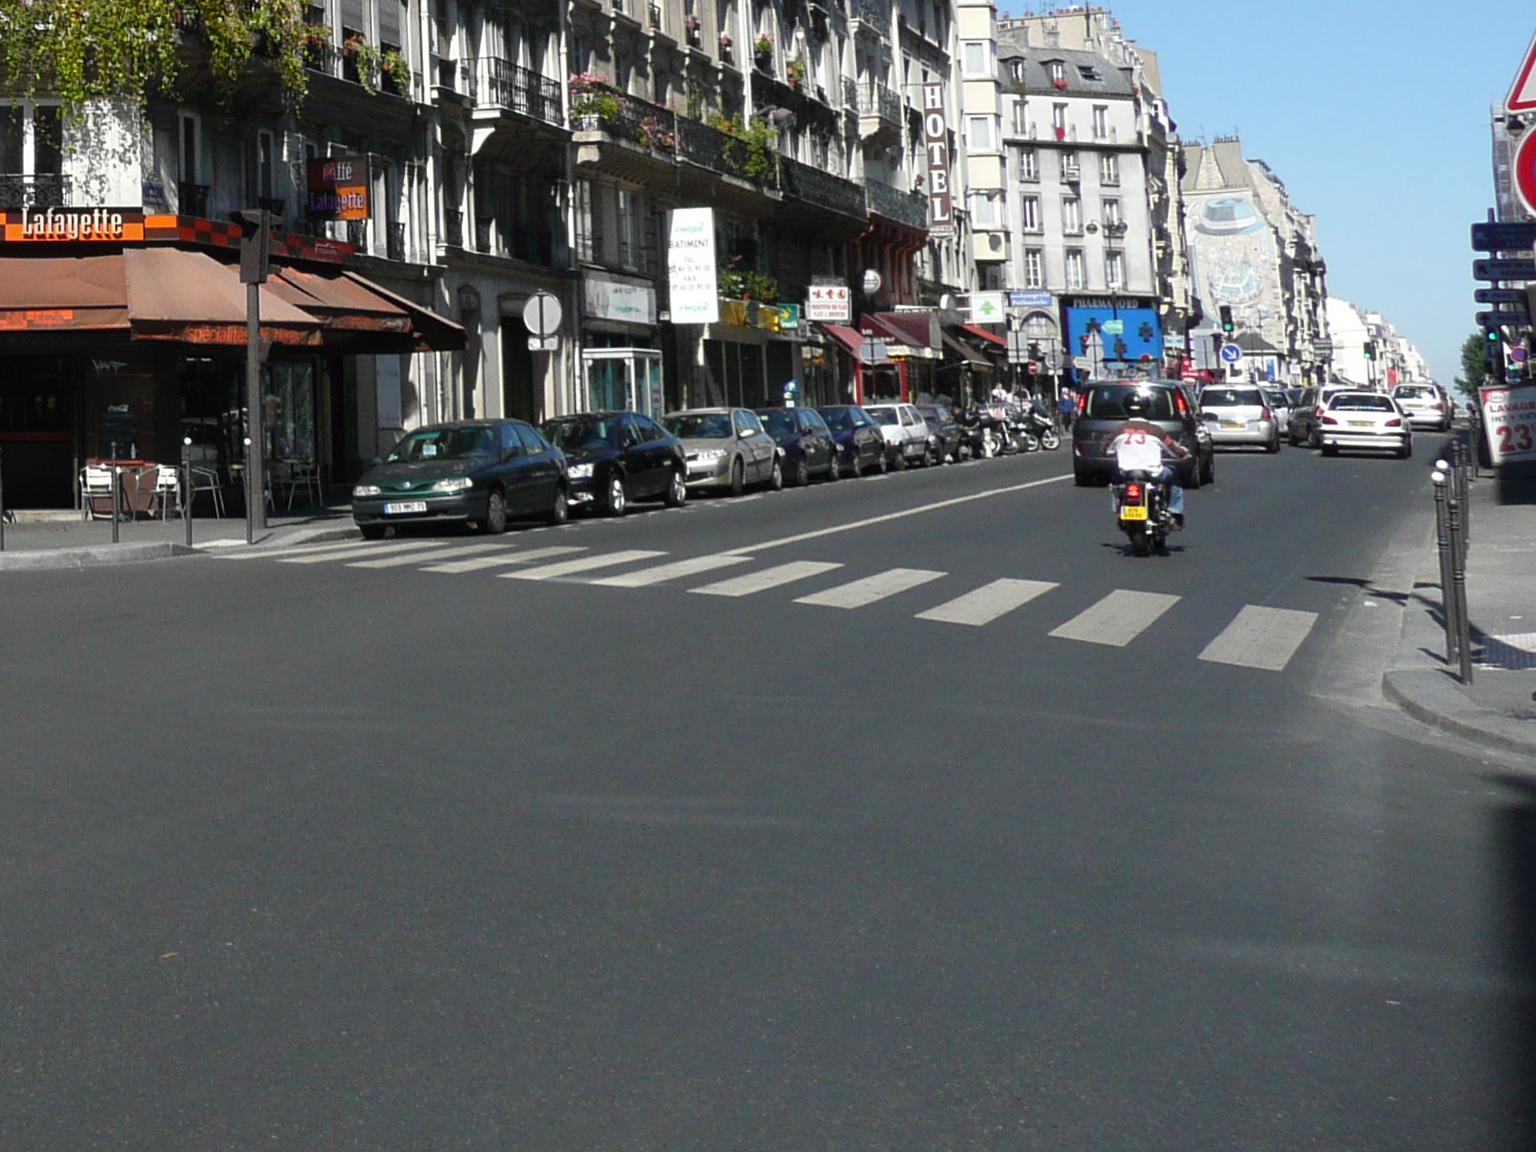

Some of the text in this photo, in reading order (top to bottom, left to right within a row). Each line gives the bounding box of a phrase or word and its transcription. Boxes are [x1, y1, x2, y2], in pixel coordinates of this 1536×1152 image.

[924, 86, 949, 221] HOTEL
[22, 207, 122, 239] Lafayette
[1124, 429, 1147, 445] 73
